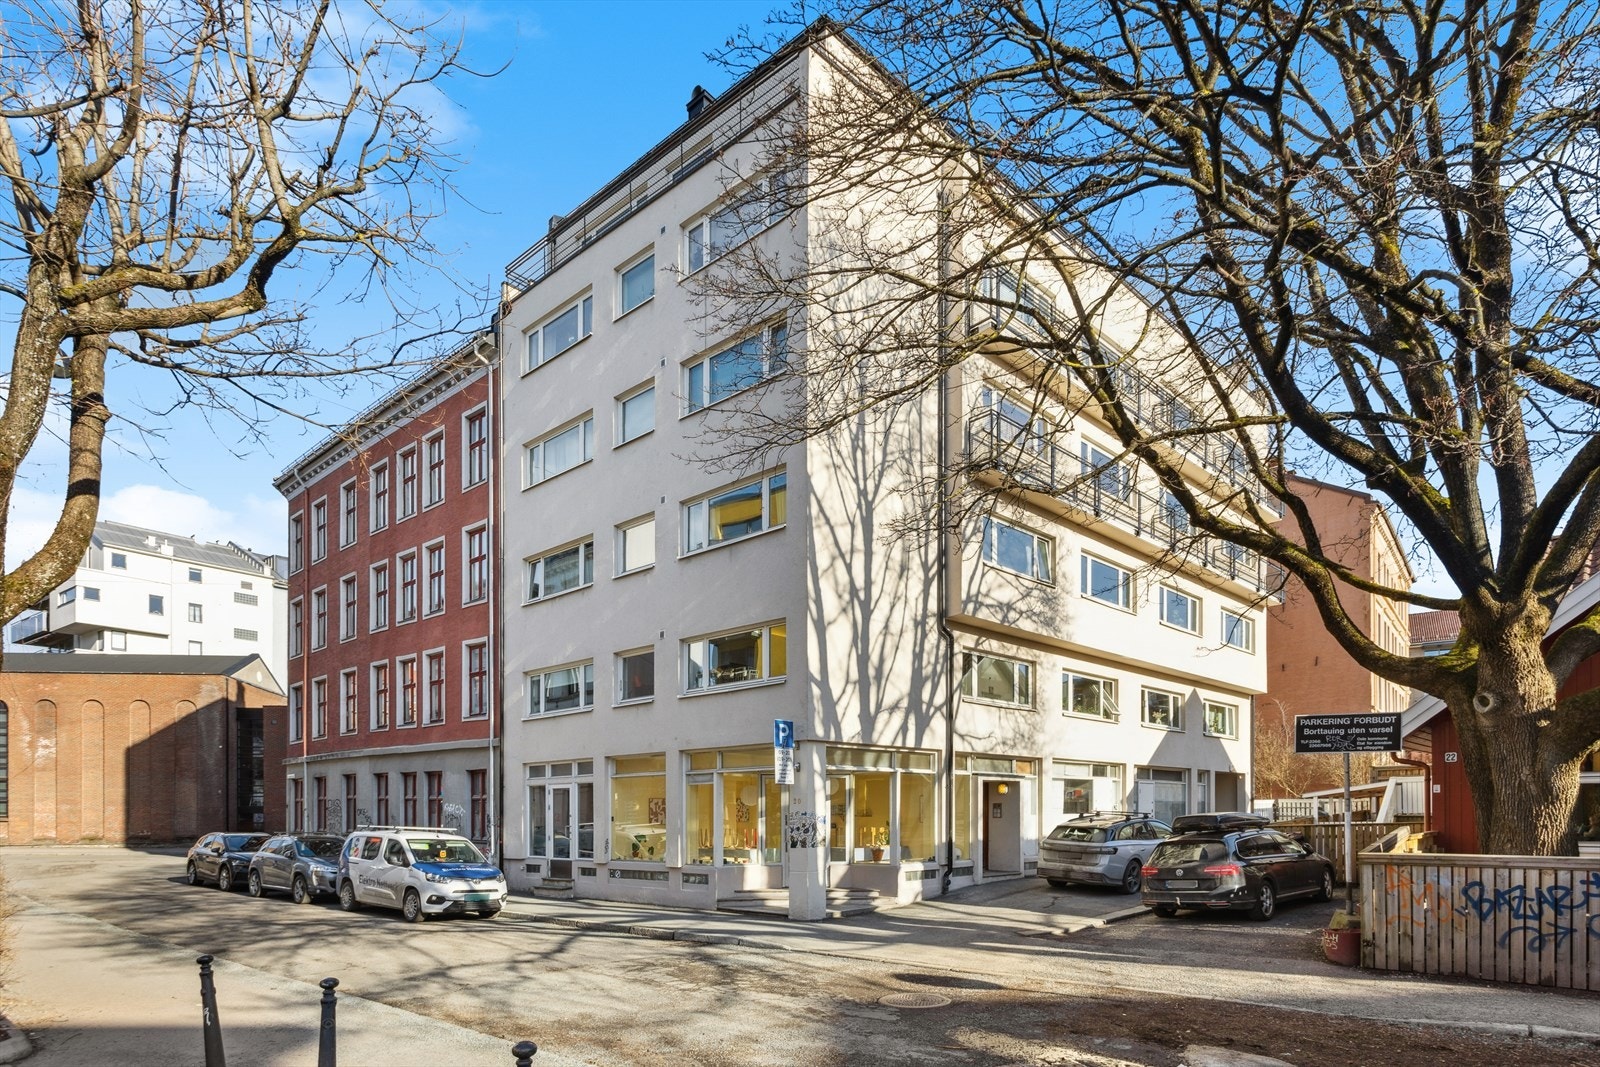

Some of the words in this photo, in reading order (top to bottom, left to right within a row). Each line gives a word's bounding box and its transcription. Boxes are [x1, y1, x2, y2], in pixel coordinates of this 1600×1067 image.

[1300, 717, 1350, 726] PARKERING
[1353, 716, 1397, 724] FORBUDT
[779, 723, 789, 744] P
[1304, 727, 1345, 736] Borttauing
[1369, 726, 1393, 734] varsel
[1446, 753, 1456, 761] 22
